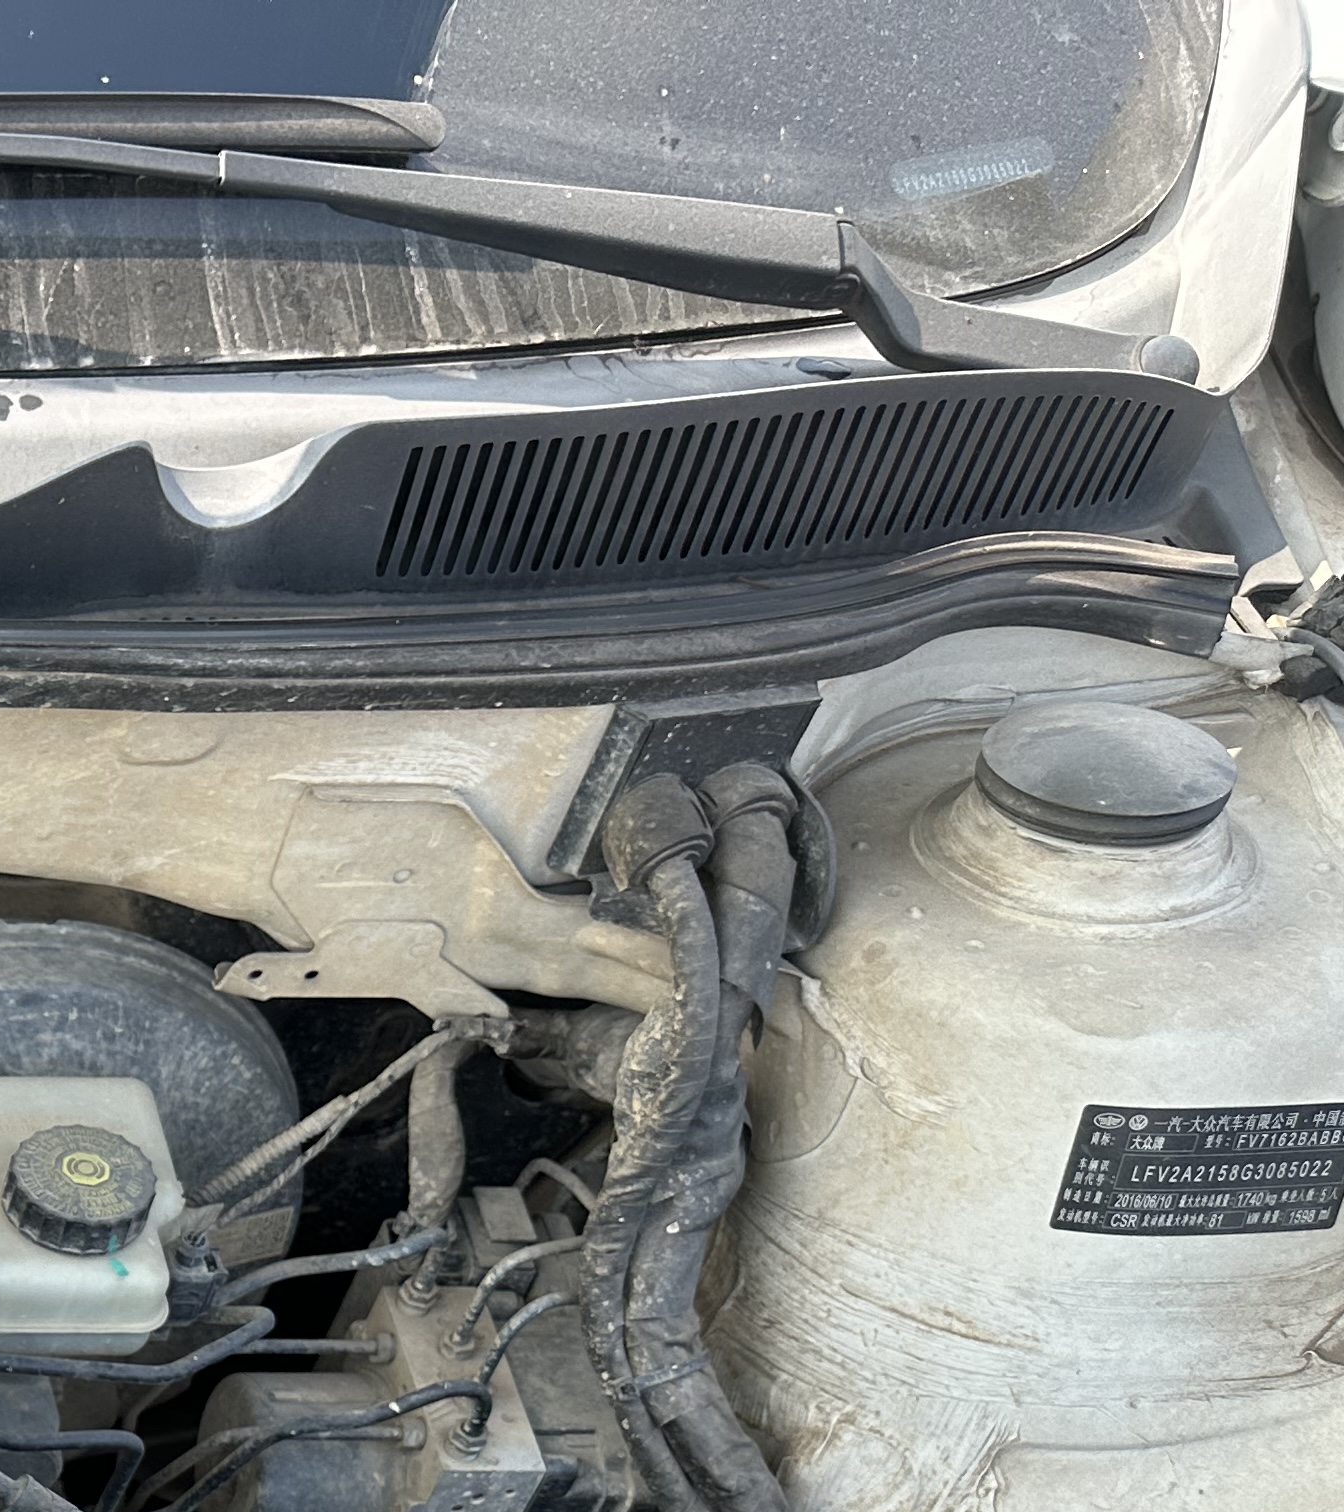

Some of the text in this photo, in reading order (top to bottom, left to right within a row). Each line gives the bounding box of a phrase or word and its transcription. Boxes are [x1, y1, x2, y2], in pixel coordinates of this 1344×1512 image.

[1130, 1135, 1166, 1150] 大众牌
[1236, 1129, 1344, 1149] FV7162BABB
[1131, 1159, 1333, 1183] LFV2A2158G3085022
[1114, 1194, 1173, 1209] 2016/06/10
[1237, 1192, 1265, 1207] 1740
[1110, 1213, 1139, 1228] CSR
[1208, 1213, 1224, 1228] 81
[1288, 1209, 1316, 1224] 1598
